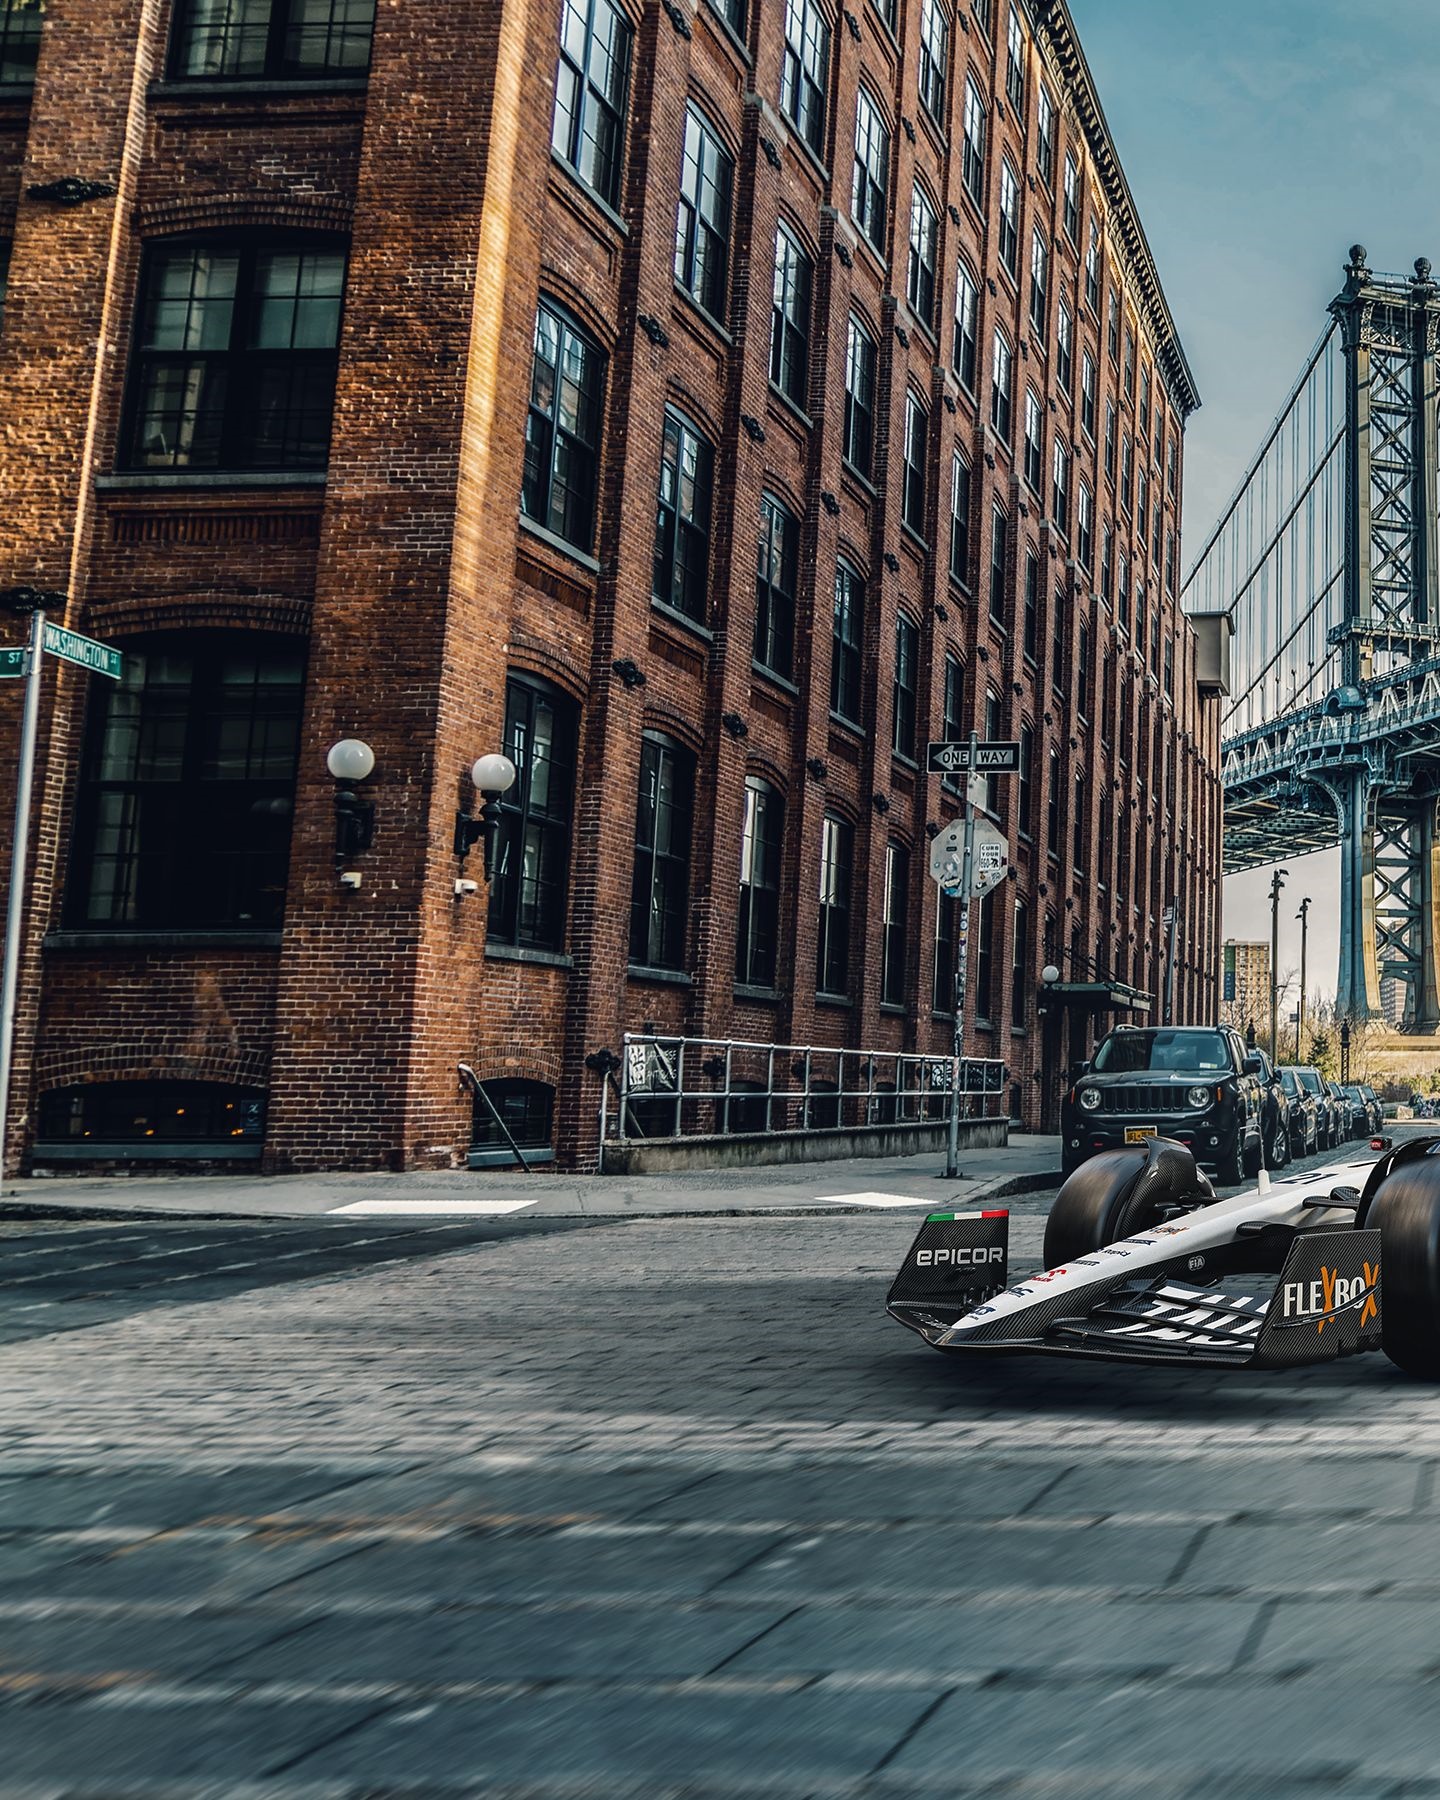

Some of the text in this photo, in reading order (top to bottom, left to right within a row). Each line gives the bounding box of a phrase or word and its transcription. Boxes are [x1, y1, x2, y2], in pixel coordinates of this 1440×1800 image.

[45, 626, 118, 670] WASHINGTON ST
[8, 652, 21, 664] ST
[942, 751, 1009, 763] ONE WAY
[1275, 1173, 1339, 1185] 21
[1284, 1261, 1380, 1335] FLEXBOX
